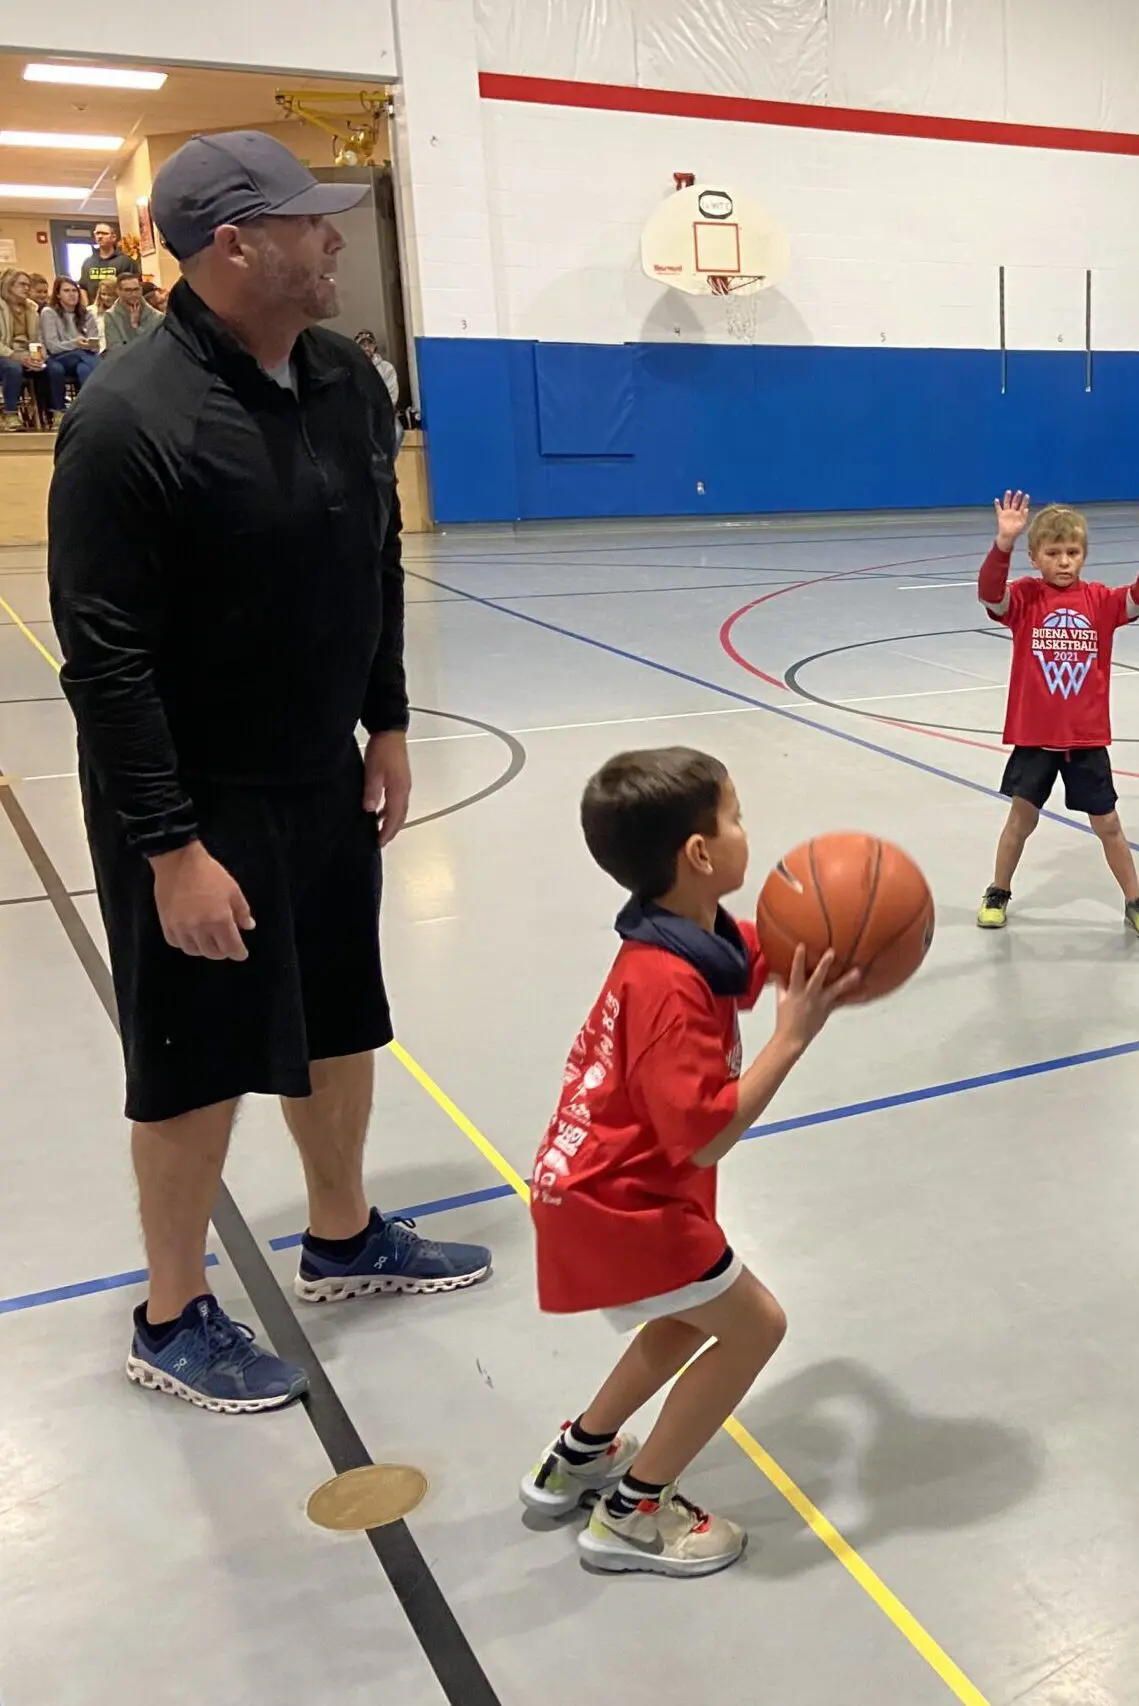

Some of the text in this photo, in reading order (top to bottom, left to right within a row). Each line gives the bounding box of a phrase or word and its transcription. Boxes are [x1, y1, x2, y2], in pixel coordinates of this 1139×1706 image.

[461, 319, 468, 330] 3
[880, 332, 887, 342] 5
[1057, 333, 1064, 343] 6
[1032, 628, 1069, 640] BUENA
[1031, 639, 1099, 652] BASKETBALL
[1053, 651, 1079, 662] 2021
